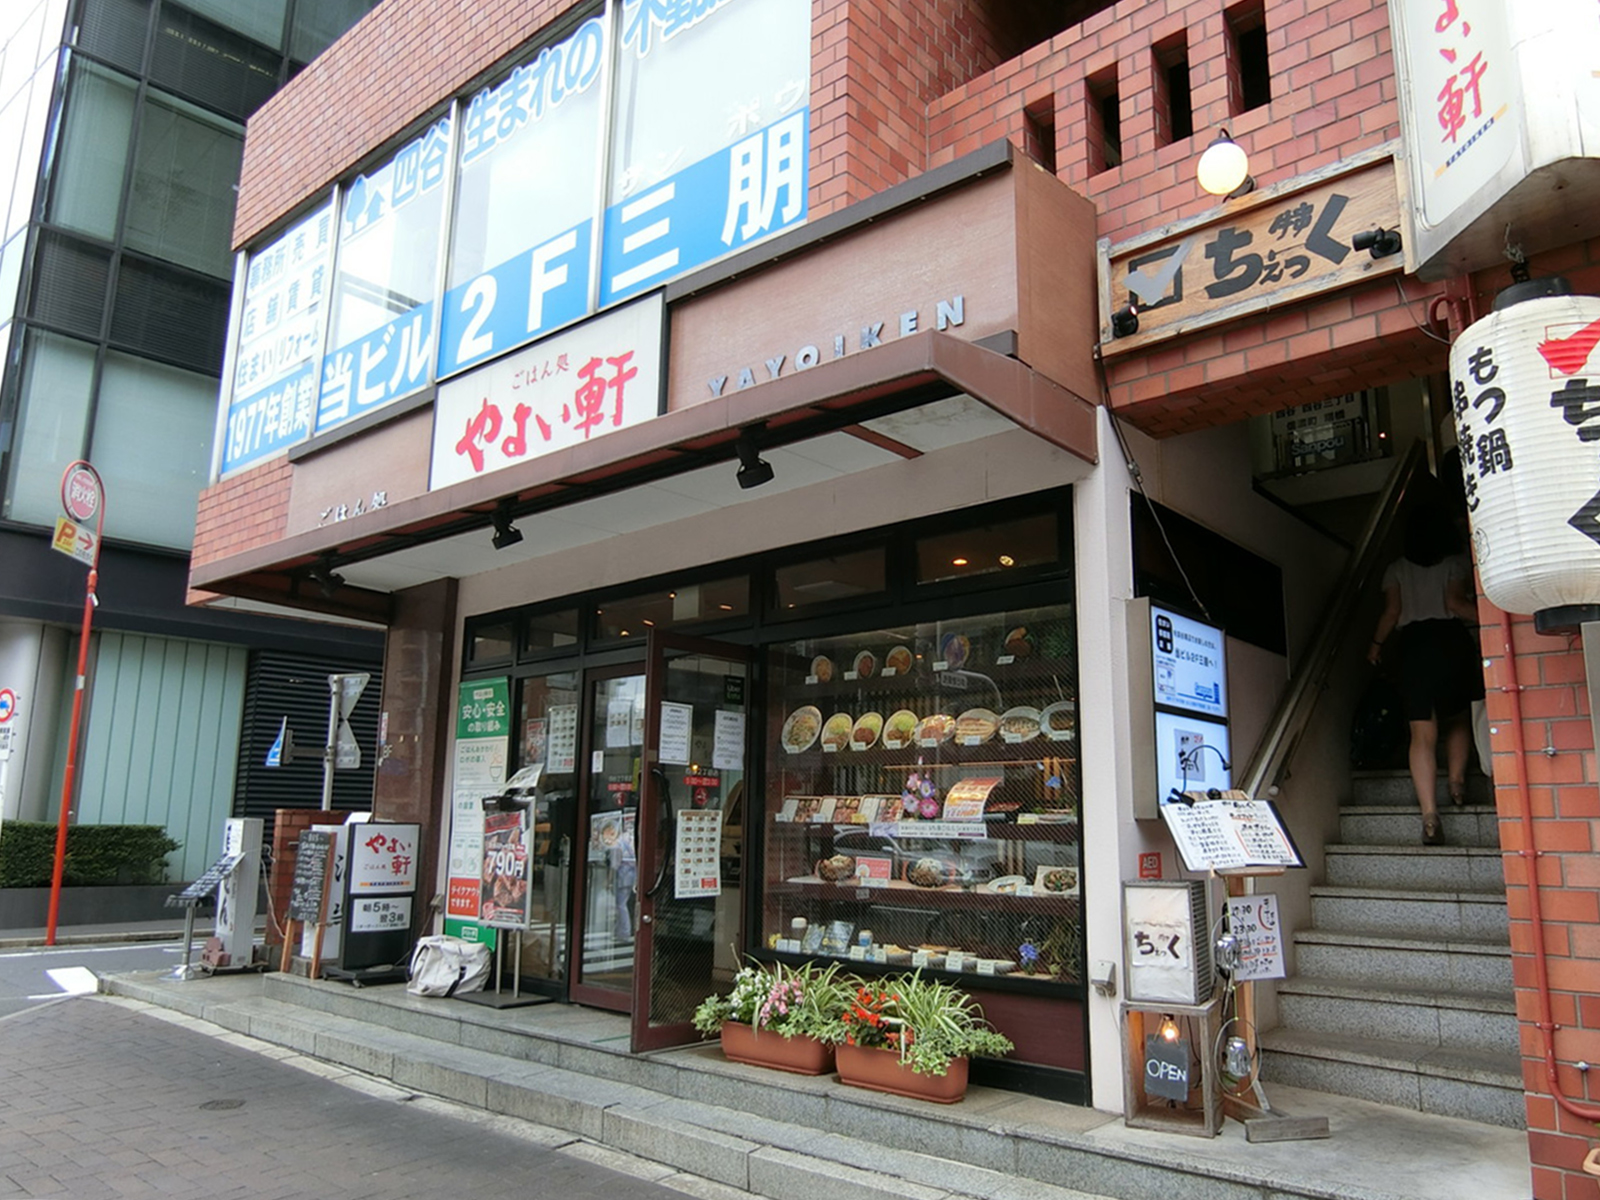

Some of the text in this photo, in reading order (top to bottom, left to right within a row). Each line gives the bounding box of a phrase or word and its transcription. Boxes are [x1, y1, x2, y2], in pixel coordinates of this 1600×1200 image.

[392, 120, 449, 208] 四谷
[462, 18, 604, 166] 生まれの
[313, 110, 806, 428] 当ビル 2F 三朋
[708, 294, 965, 398] YAYOIKEN
[511, 352, 571, 391] ごはん処
[226, 373, 315, 464] 1977年創業
[455, 350, 639, 474] やよい軒
[1468, 346, 1515, 479] もつ鍋
[1291, 435, 1345, 456] Sanpou
[56, 521, 77, 544] P
[365, 833, 412, 854] やよい
[391, 855, 412, 876] 軒
[486, 850, 525, 879] 790円
[1142, 855, 1158, 869] AED
[1146, 1058, 1187, 1082] OPEN
